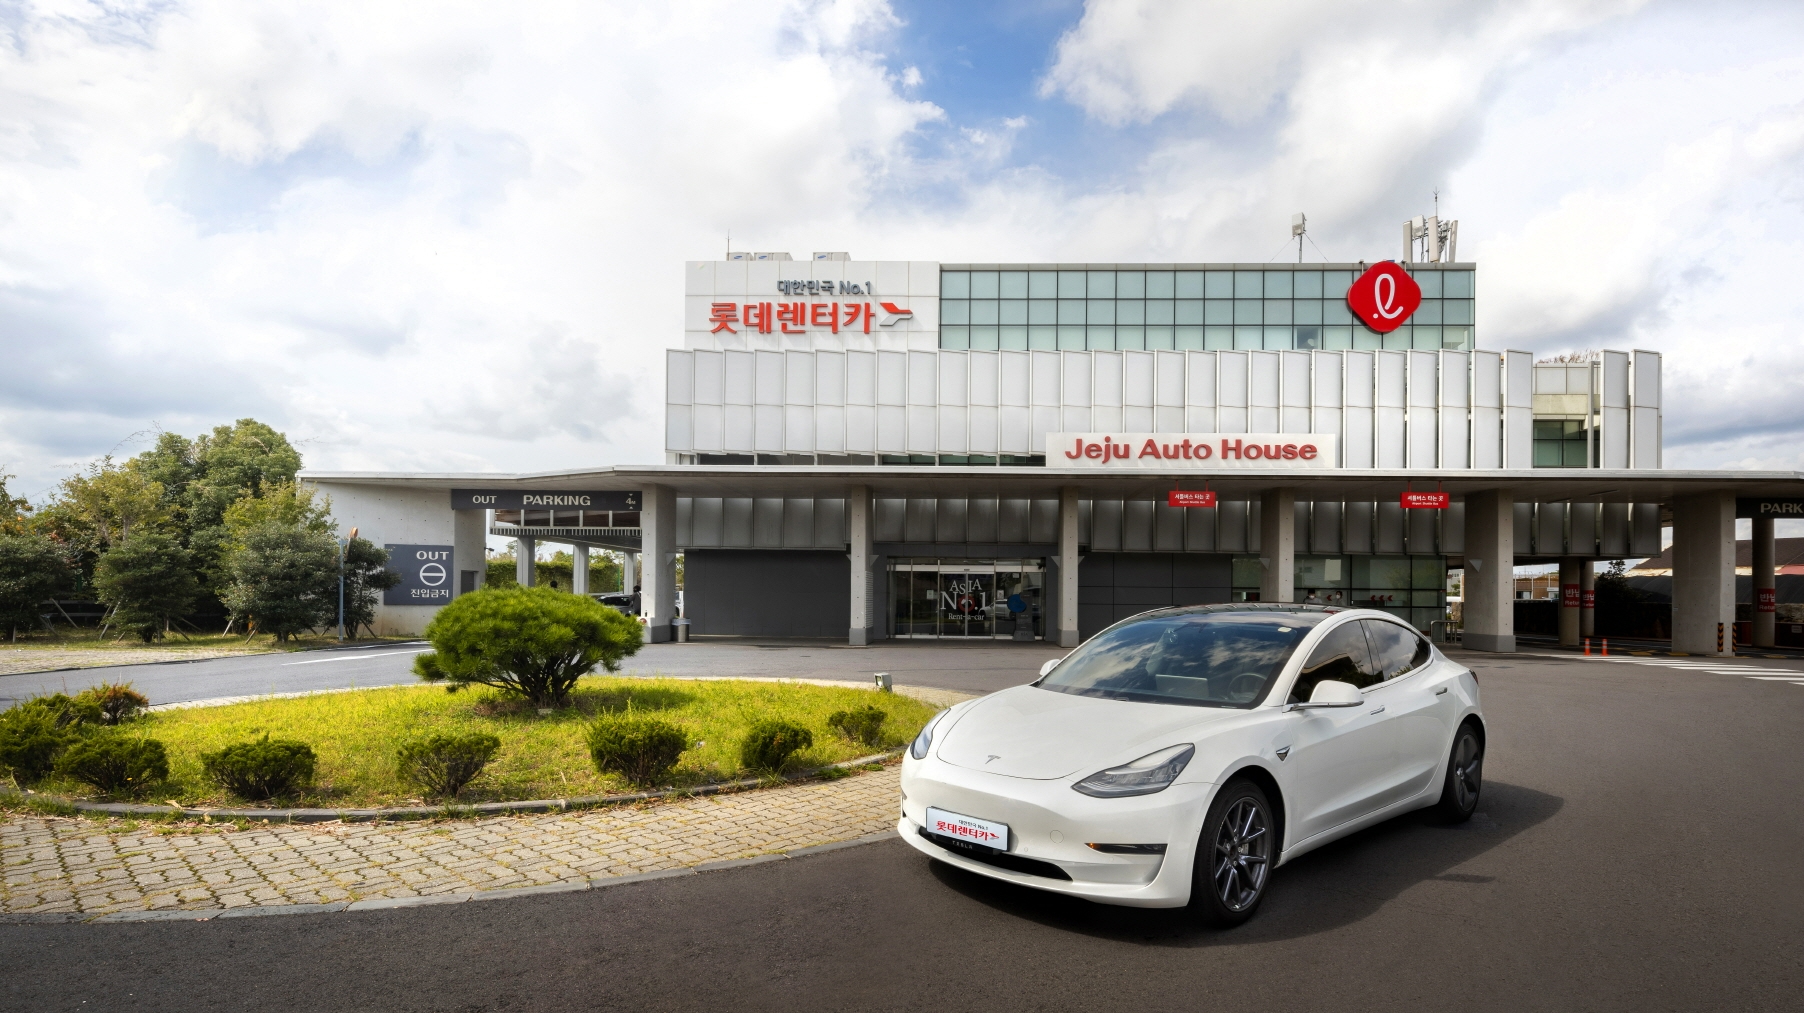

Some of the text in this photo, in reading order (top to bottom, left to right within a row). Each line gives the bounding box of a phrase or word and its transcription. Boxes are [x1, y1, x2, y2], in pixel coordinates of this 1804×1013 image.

[777, 280, 872, 296] 대한민국 No.1
[709, 302, 876, 334] 롯데렌터카
[1064, 436, 1318, 464] Jeju Auto House
[472, 495, 497, 504] OUT
[523, 494, 591, 506] PARKING
[1760, 502, 1804, 514] PARK
[416, 550, 449, 560] OUT
[949, 578, 982, 595] ASIA
[410, 588, 449, 598] 진입금지
[948, 613, 985, 621] Rent-a-car
[937, 820, 988, 840] 롯데렌터카
[952, 840, 973, 849] TESLA
